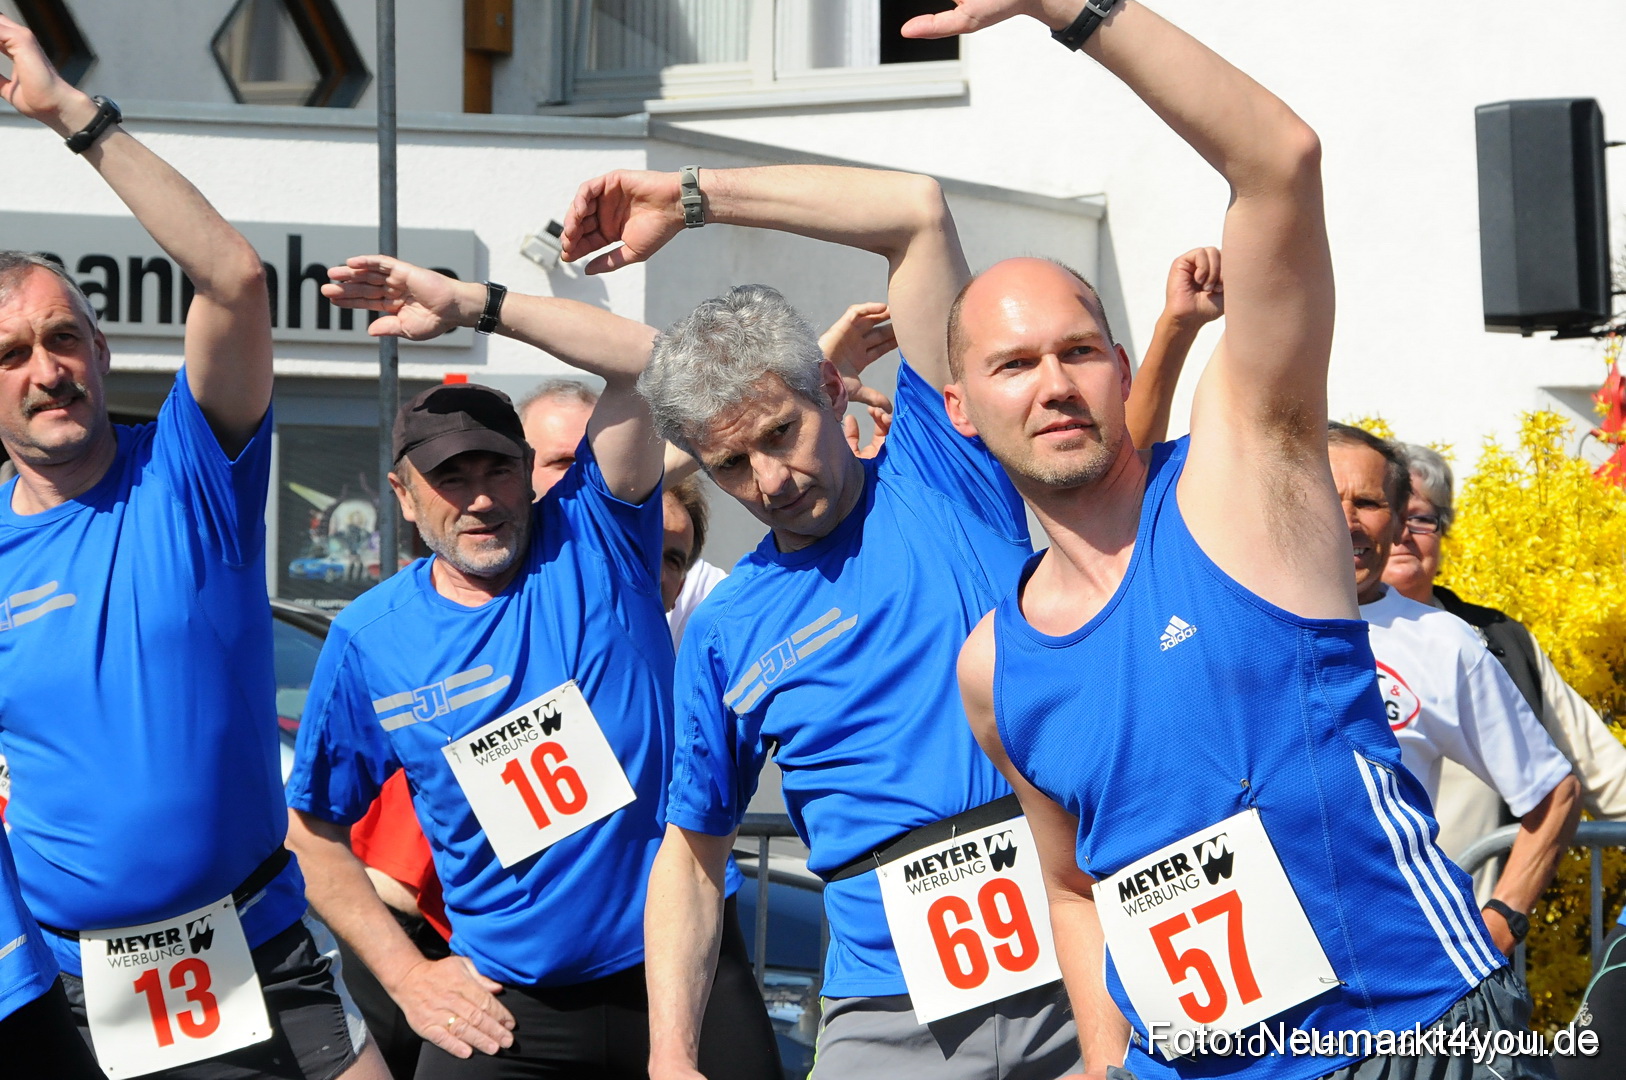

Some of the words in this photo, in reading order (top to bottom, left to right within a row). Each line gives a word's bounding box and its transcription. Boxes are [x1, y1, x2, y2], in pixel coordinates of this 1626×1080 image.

[1160, 625, 1197, 651] adidas
[469, 715, 534, 758] MEYER
[476, 729, 539, 766] WERBUNG
[500, 741, 588, 830] 16
[903, 841, 982, 883] MEYER
[907, 860, 986, 895] WERBUNG
[1117, 852, 1194, 903] MEYER
[1123, 873, 1201, 917] WERBUNG
[106, 928, 183, 956] MEYER
[927, 877, 1040, 990] 69
[107, 944, 186, 969] WERBUNG
[1149, 889, 1263, 1024] 57
[133, 957, 221, 1048] 13
